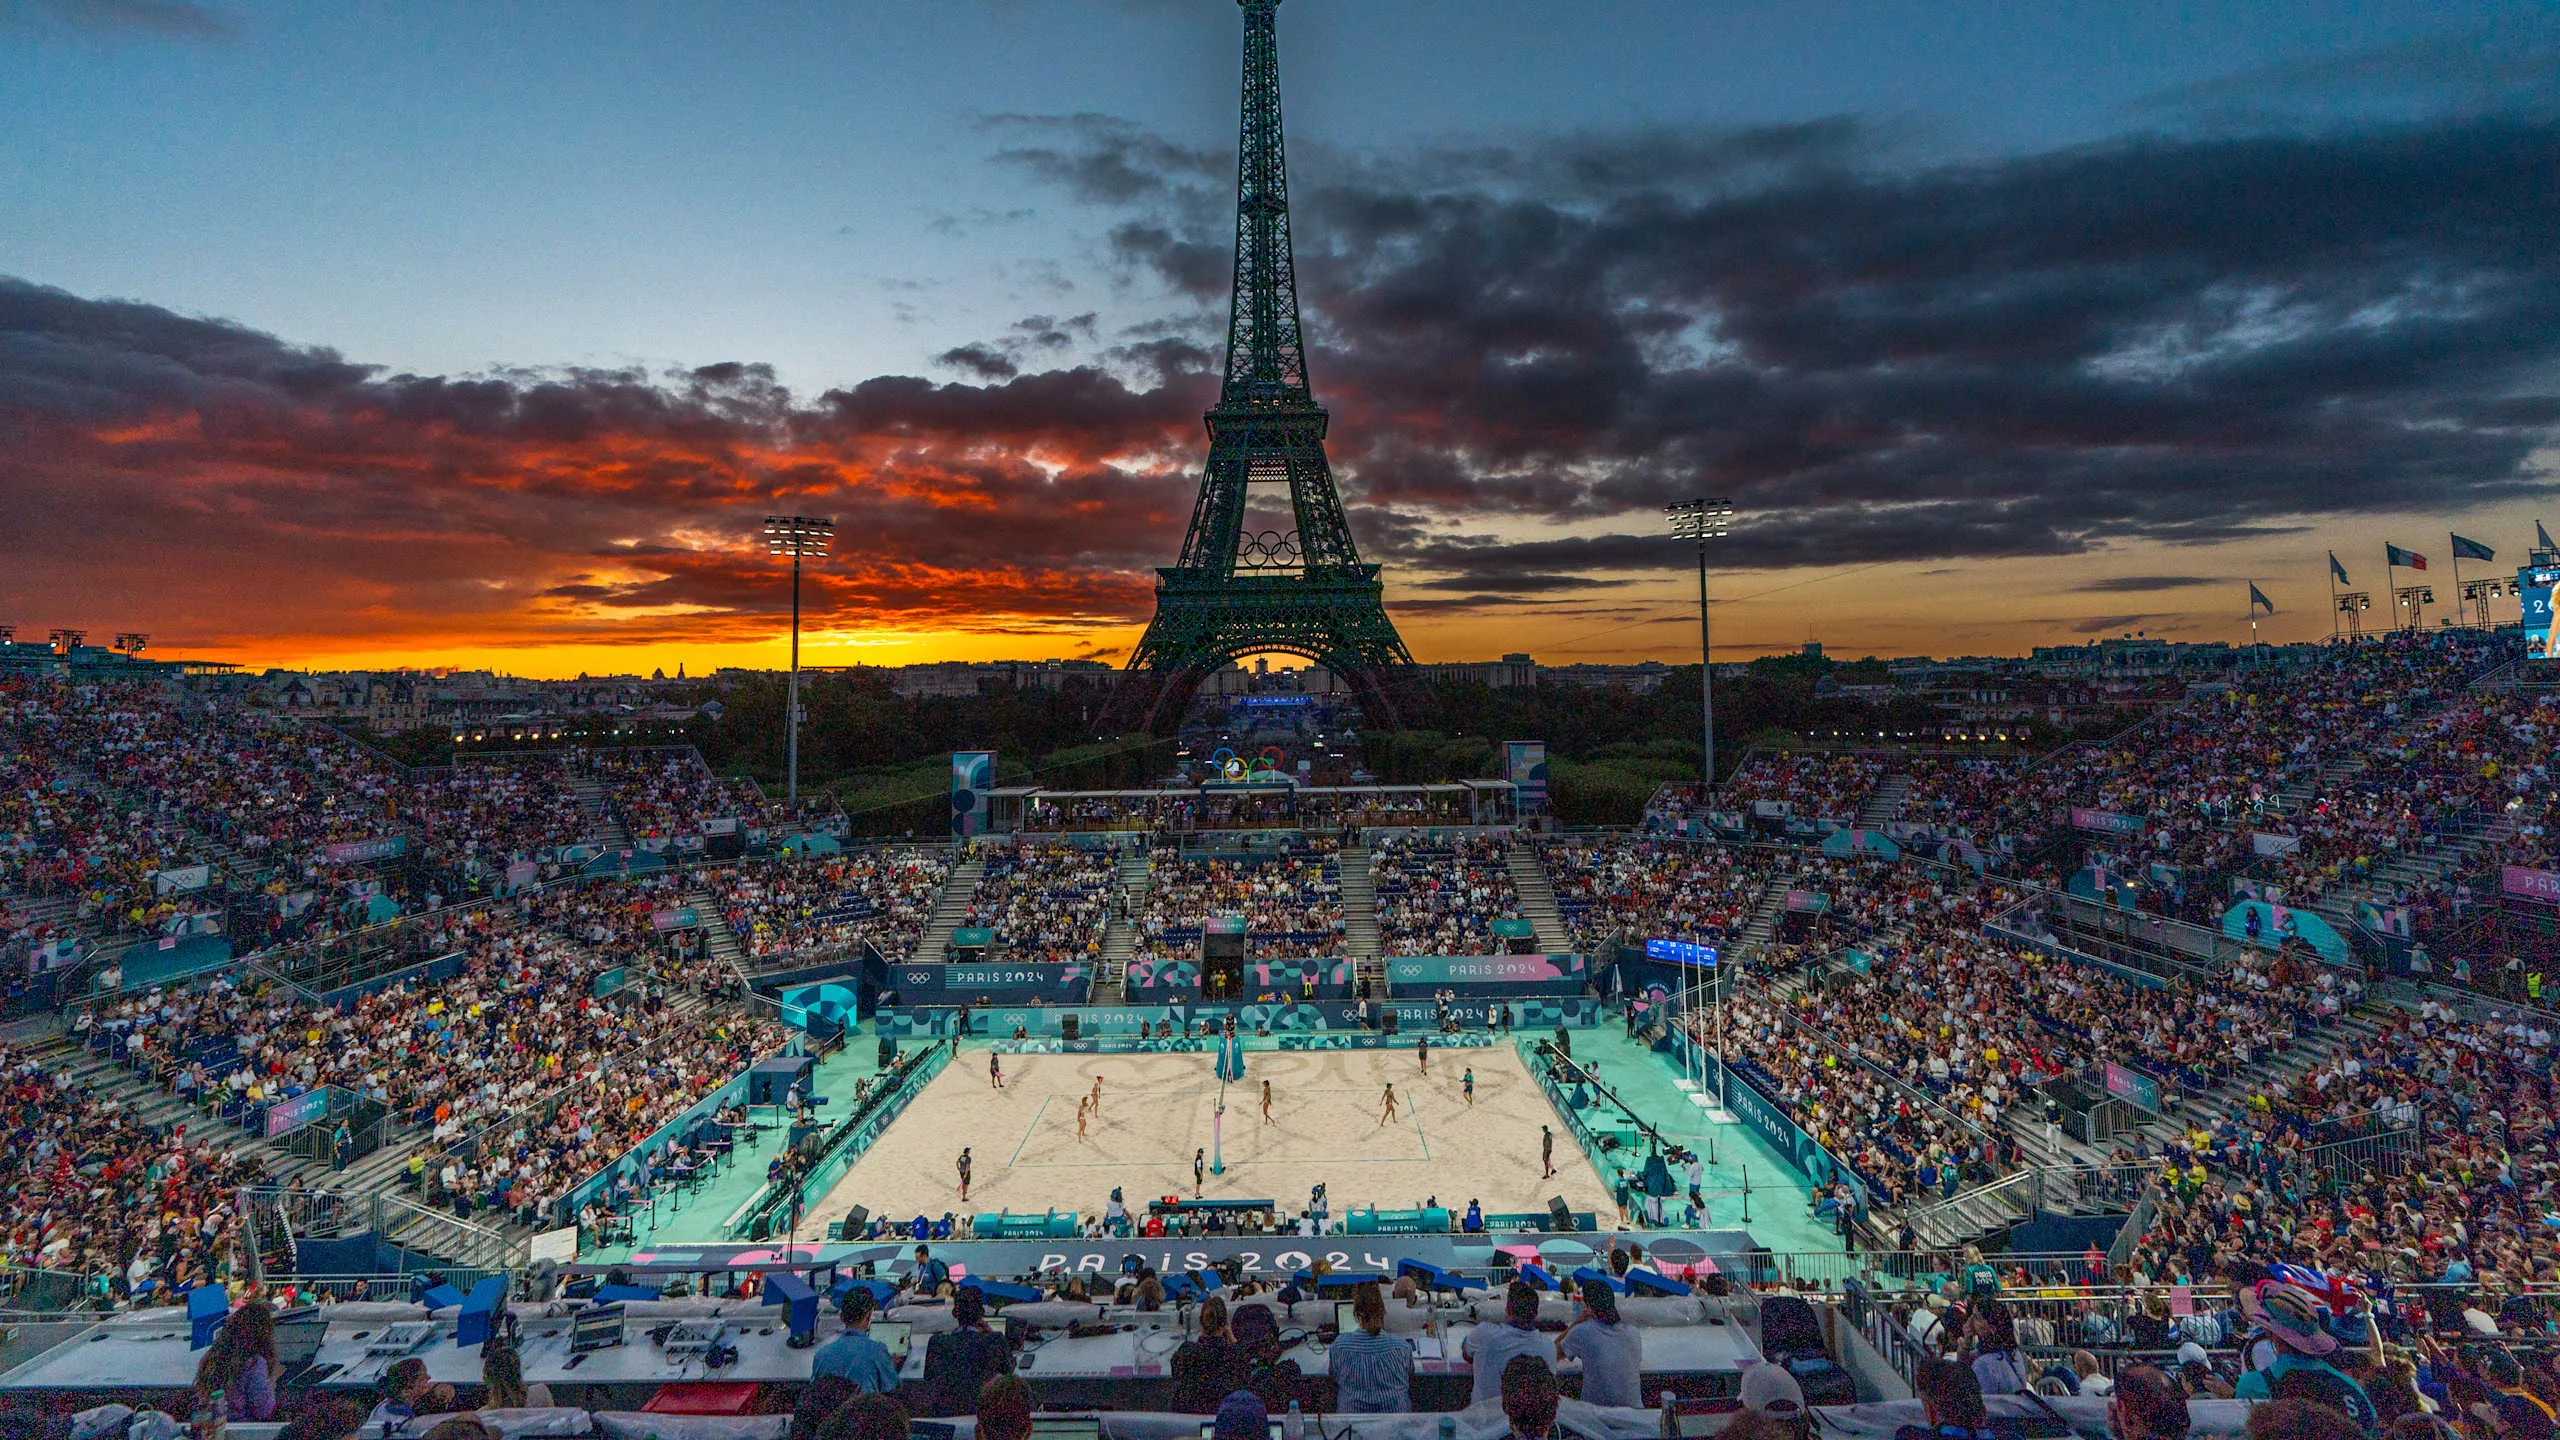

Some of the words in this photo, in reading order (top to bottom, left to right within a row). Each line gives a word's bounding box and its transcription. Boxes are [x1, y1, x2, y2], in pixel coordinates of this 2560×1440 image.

[1005, 971, 1044, 983] 2024
[1497, 963, 1536, 975] 2024
[1764, 1115, 1790, 1148] 2024
[1240, 1251, 1389, 1272] 2024
